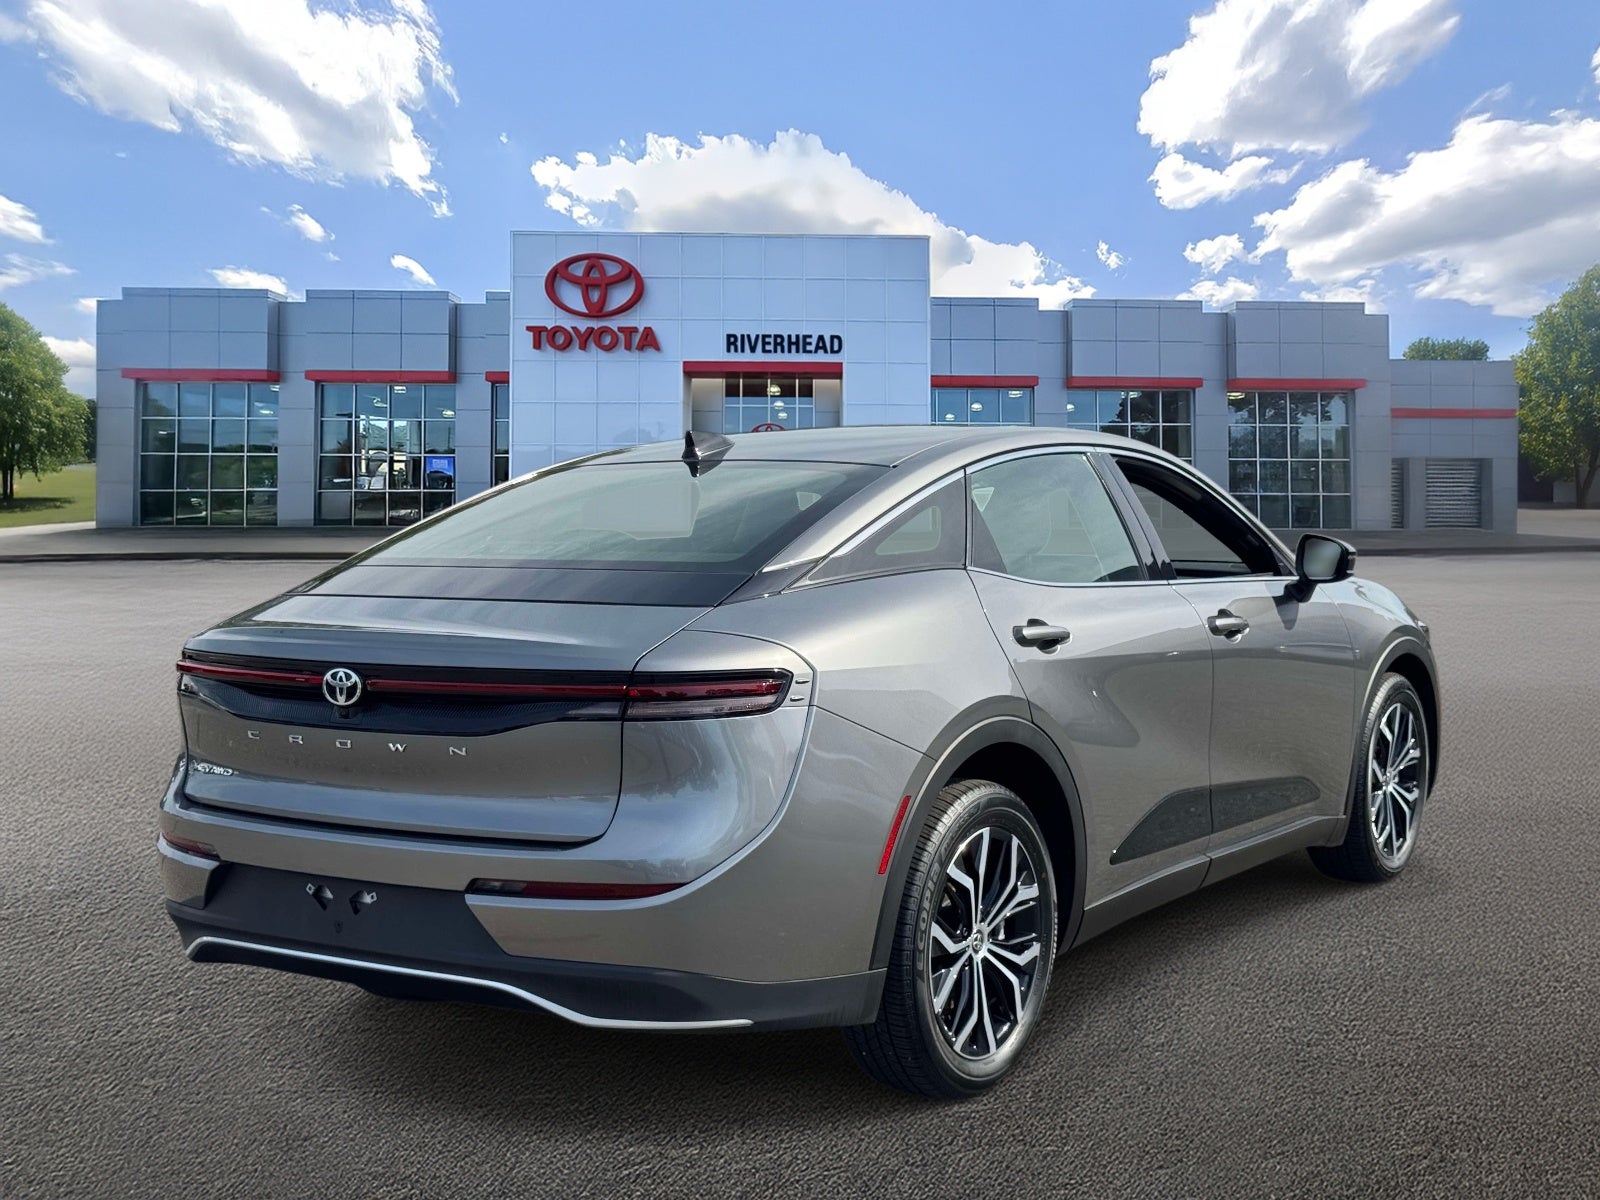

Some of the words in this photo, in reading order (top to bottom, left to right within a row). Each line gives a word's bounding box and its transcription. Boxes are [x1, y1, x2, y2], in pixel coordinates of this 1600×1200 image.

[525, 325, 661, 351] TOYOTA
[726, 333, 843, 354] RIVERHEAD
[247, 730, 467, 756] CROWN
